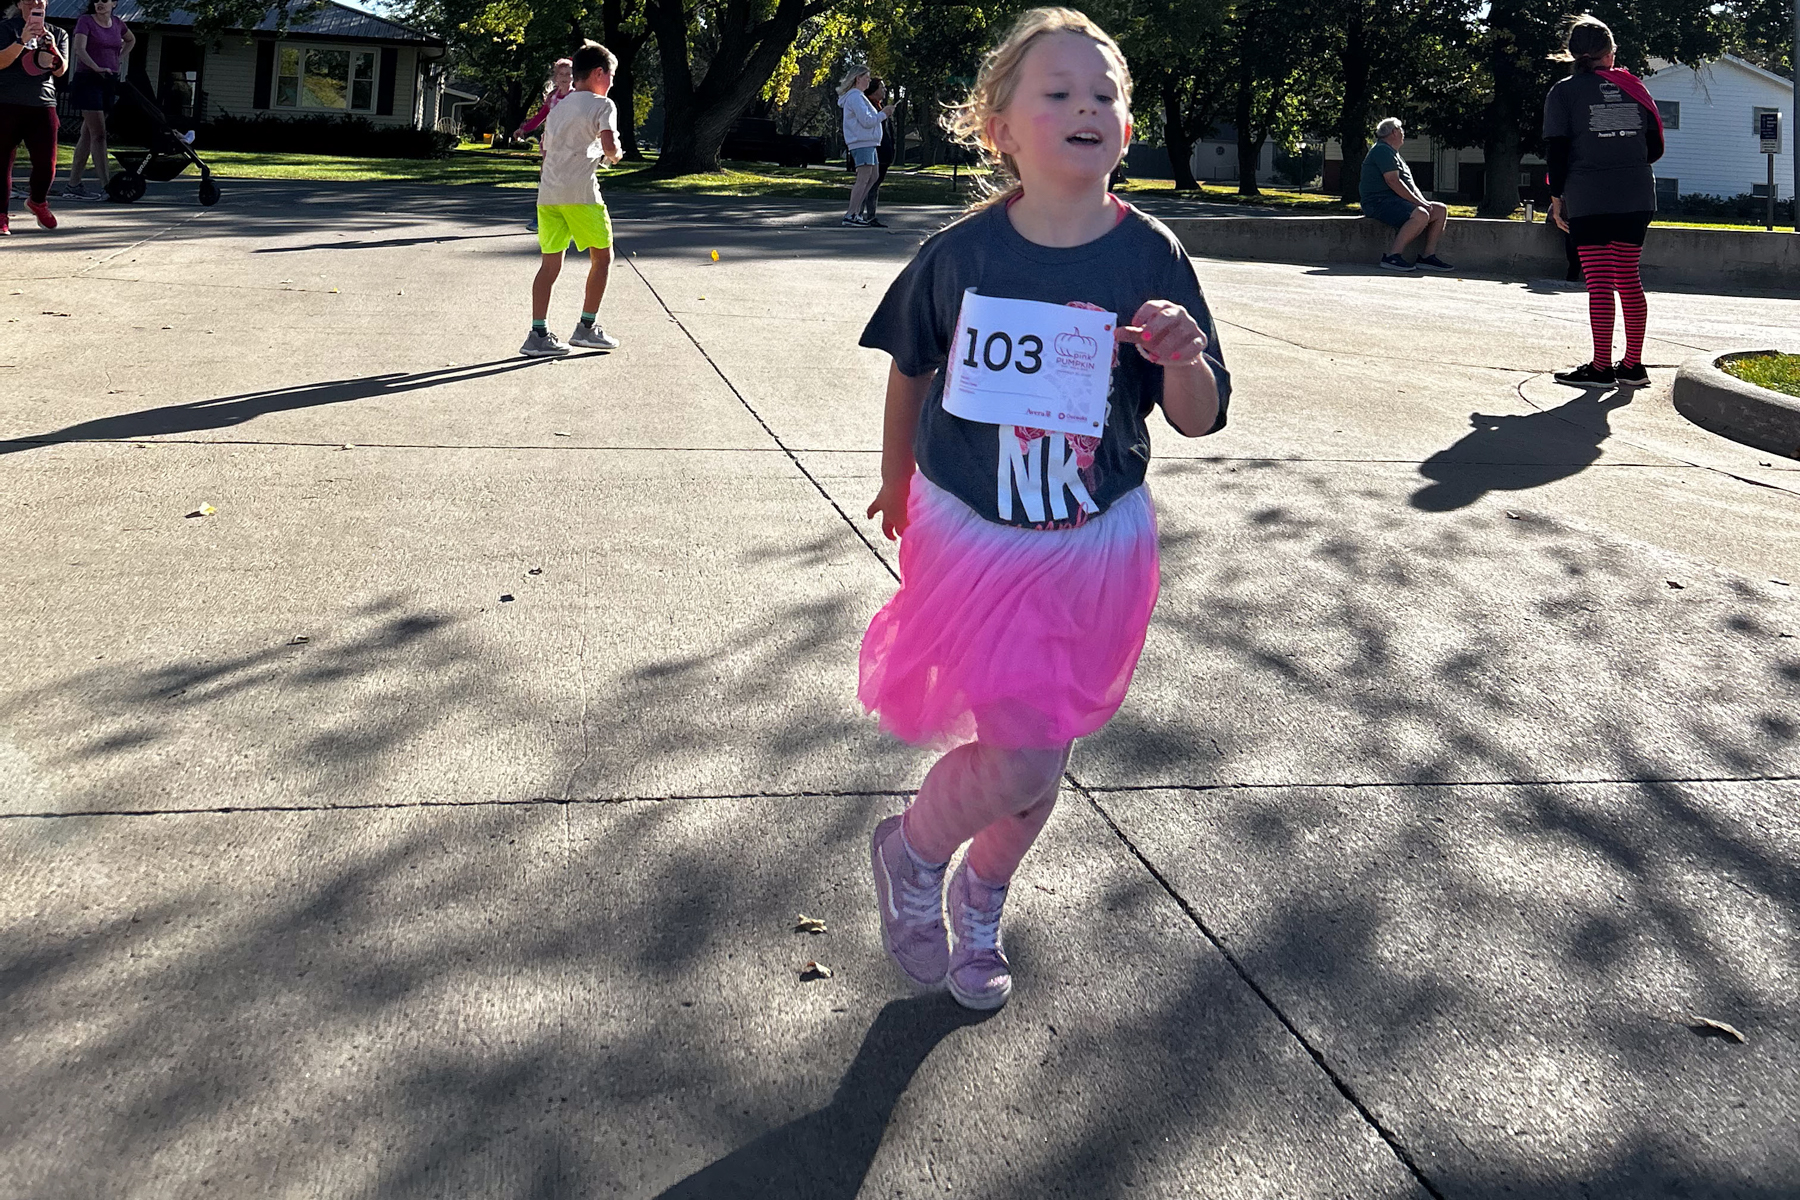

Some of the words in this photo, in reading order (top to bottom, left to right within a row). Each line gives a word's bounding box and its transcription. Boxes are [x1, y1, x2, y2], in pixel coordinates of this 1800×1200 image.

[136, 153, 152, 175] BRAVO
[963, 327, 1044, 375] 103
[1073, 353, 1092, 361] pink
[1056, 356, 1095, 370] PUMPKIN
[1026, 407, 1045, 417] Avera
